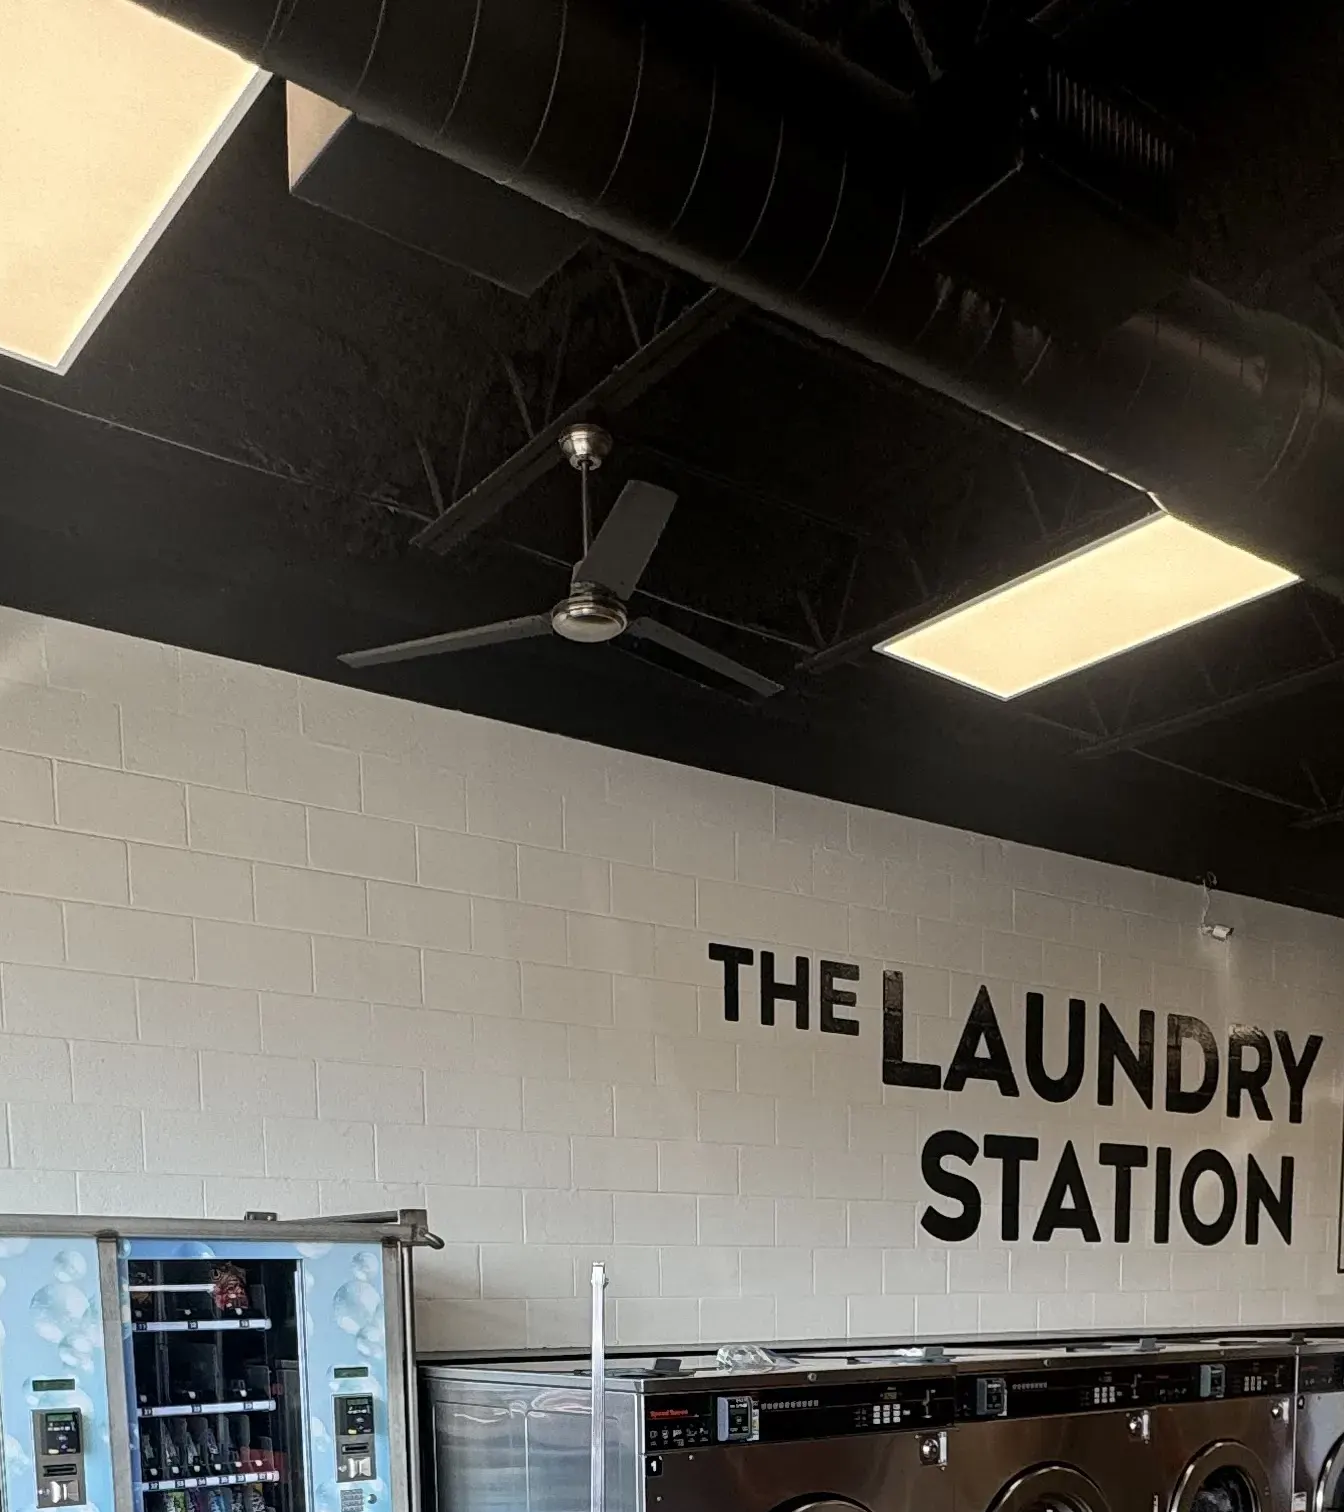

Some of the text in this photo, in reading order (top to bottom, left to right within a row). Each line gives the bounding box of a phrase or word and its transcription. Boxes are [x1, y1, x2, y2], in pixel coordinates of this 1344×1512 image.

[709, 942, 1324, 1124] THE LAUNDRY
[919, 1129, 1295, 1246] STATION
[650, 1460, 657, 1472] 1
